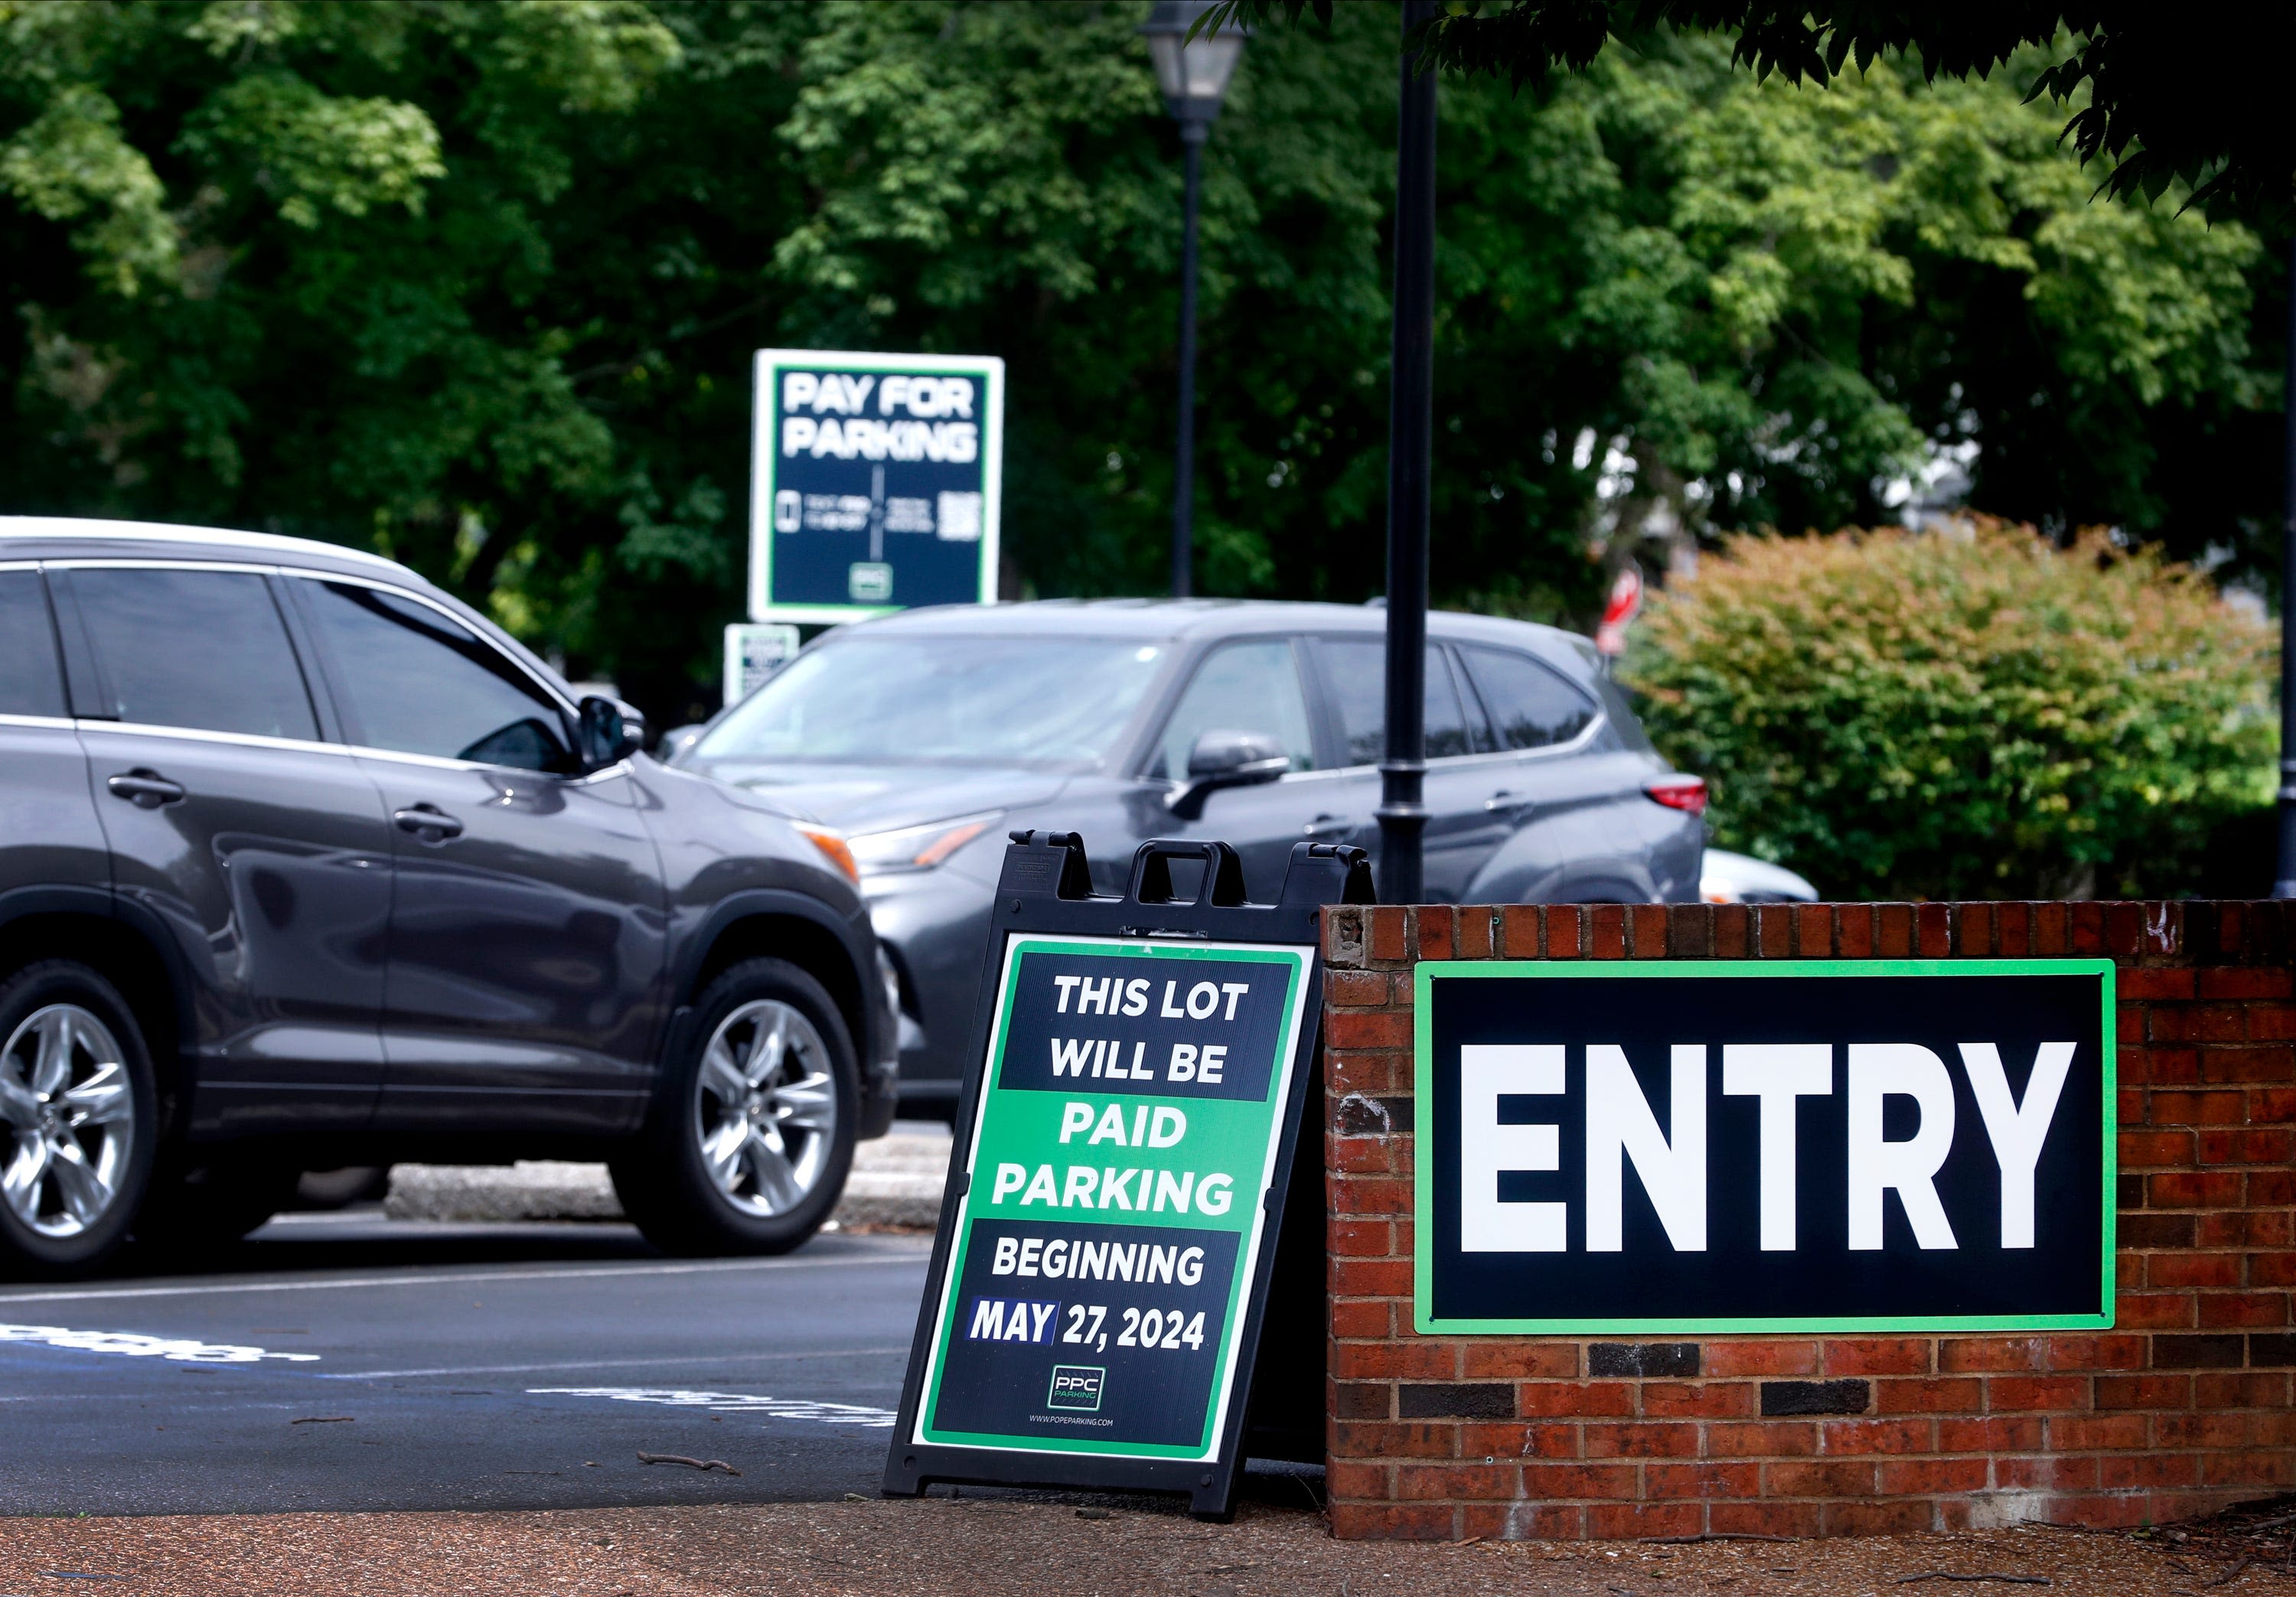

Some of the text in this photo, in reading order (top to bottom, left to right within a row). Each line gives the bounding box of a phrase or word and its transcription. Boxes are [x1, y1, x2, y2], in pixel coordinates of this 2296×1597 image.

[783, 372, 975, 419] PAY FOR
[782, 416, 977, 463] PARKING
[1054, 975, 1249, 1021] THIS LOT
[1051, 1038, 1228, 1084] WILL BE
[1058, 1103, 1187, 1149] PAID
[1461, 1041, 2077, 1253] ENTRY
[991, 1162, 1233, 1216] PARKING
[992, 1237, 1204, 1286] BEGINNING
[970, 1300, 1205, 1353] MAY 27, 2024
[1054, 1390, 1097, 1400] PARKING
[1055, 1377, 1098, 1391] PPC
[1029, 1414, 1114, 1427] WWW.POPEPARKING.COM
